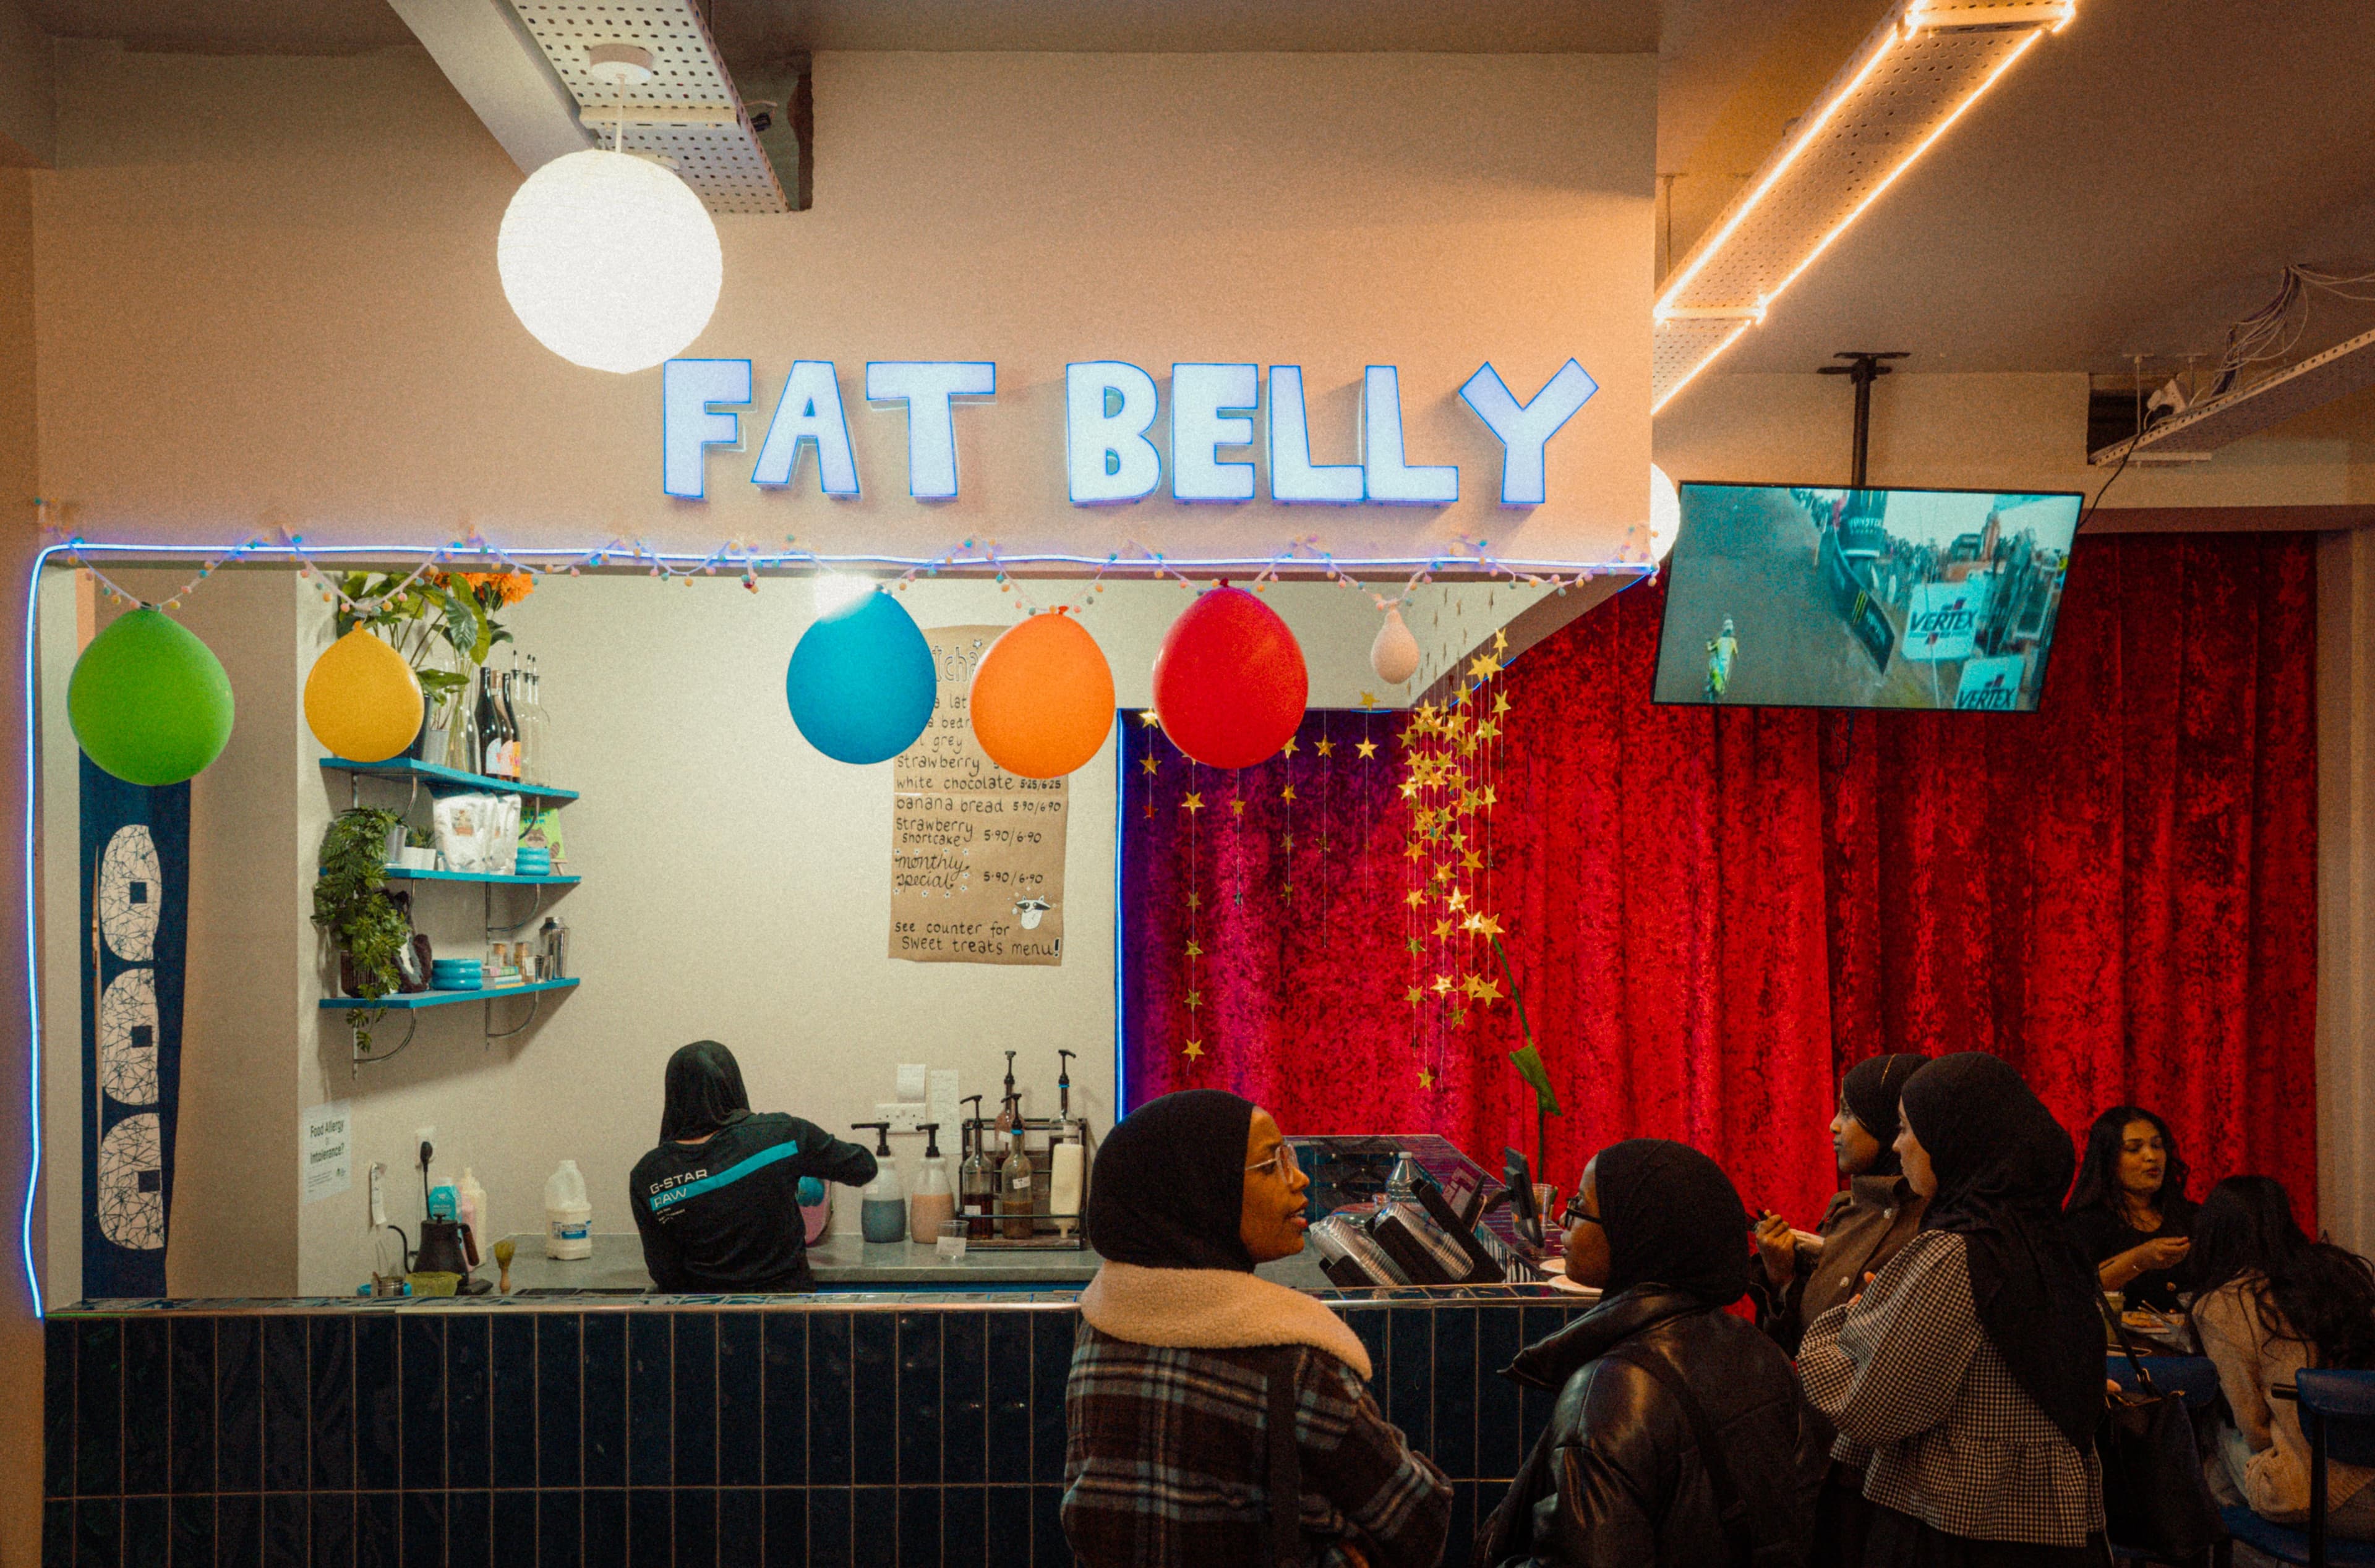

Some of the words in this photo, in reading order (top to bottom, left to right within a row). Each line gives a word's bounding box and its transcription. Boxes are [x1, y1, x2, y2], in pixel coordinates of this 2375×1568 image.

[664, 359, 996, 502] FAT
[1066, 357, 1599, 507] BELLY
[1909, 608, 1978, 631] VERTEX
[1957, 688, 2017, 709] VERTEX
[931, 735, 962, 754] grey
[897, 755, 980, 777] strawberry
[897, 777, 933, 790] white
[944, 777, 1015, 790] chocolate
[897, 796, 953, 811] banana
[961, 797, 1003, 813] bread
[902, 832, 961, 846] shortcake
[895, 854, 970, 880] monthly
[896, 871, 954, 892] special
[895, 921, 916, 932] see
[926, 922, 982, 935] counter
[990, 921, 1010, 938] for
[952, 939, 1003, 955] treats
[1012, 938, 1059, 958] menu!
[310, 1122, 324, 1138] Food
[325, 1120, 344, 1134] Allergy
[310, 1142, 344, 1165] Intolerance?
[650, 1169, 708, 1195] G-STAR
[654, 1187, 687, 1208] RAW
